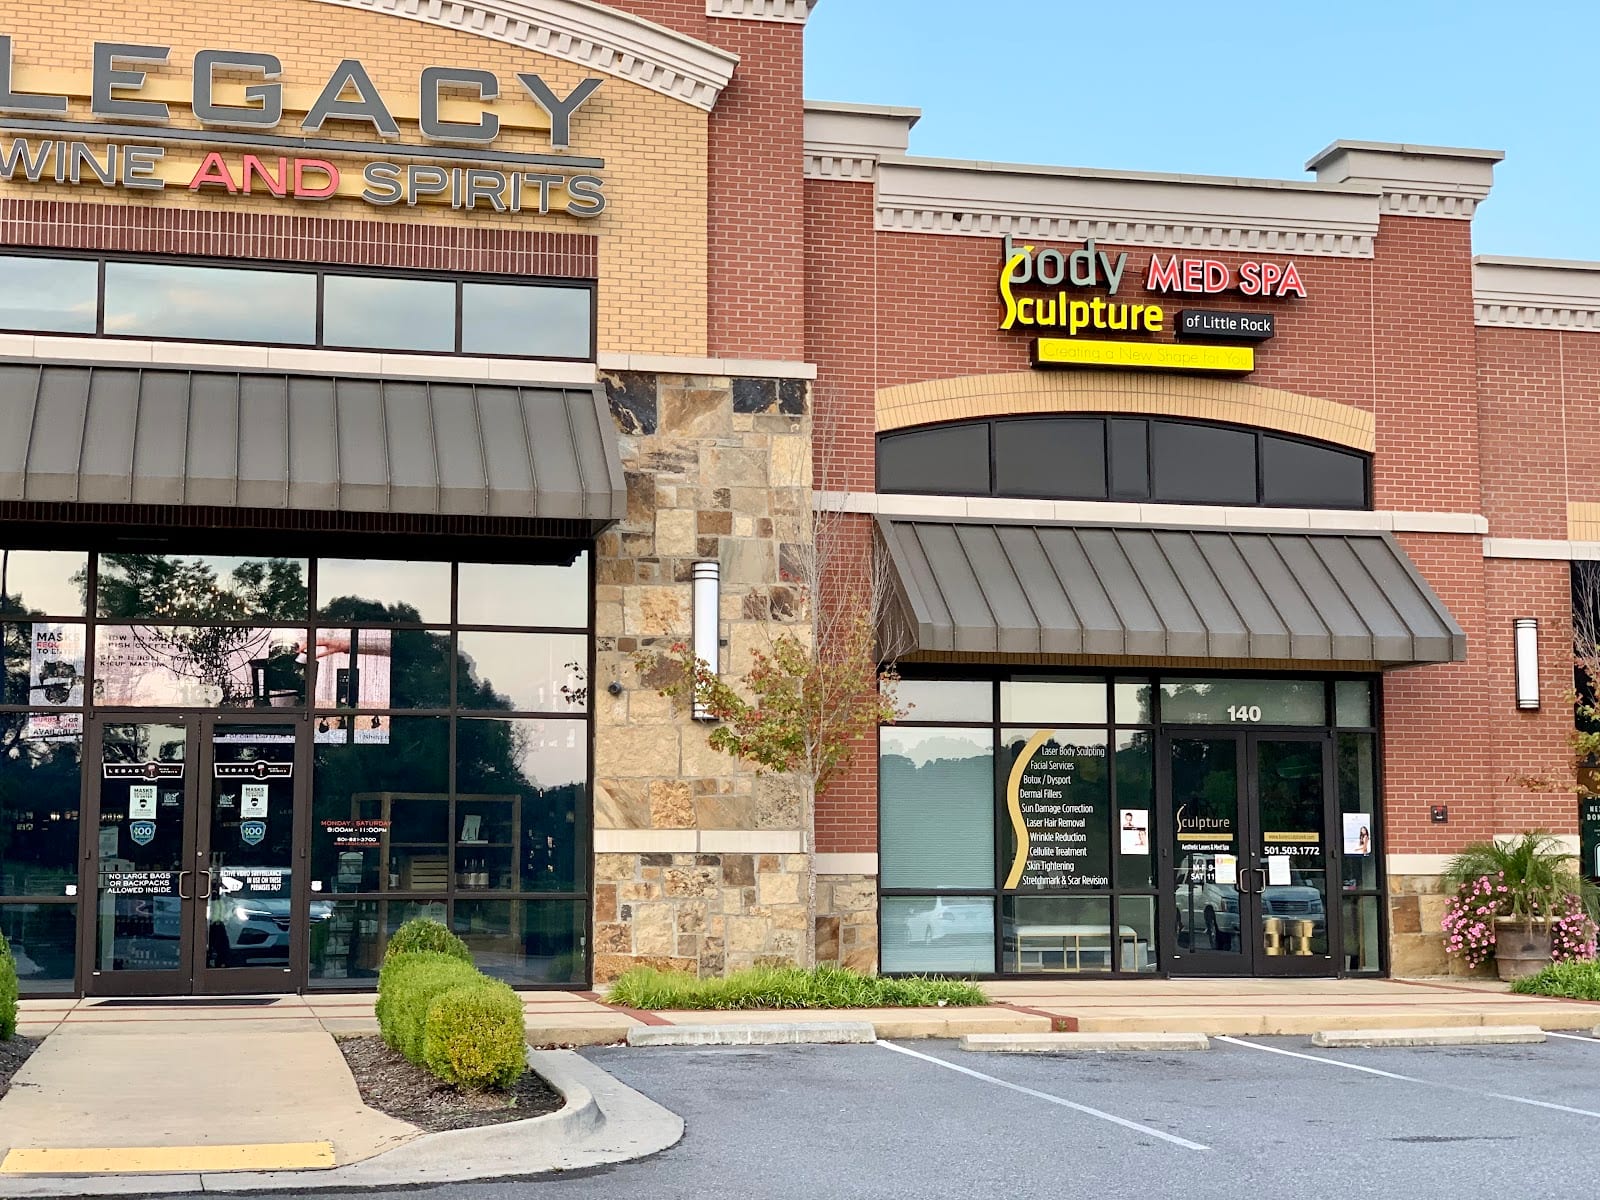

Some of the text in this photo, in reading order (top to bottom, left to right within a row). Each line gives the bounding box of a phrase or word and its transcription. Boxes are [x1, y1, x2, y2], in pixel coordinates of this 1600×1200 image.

[0, 35, 605, 150] LEGACY
[0, 138, 608, 217] WINE AND SPIRITS
[1004, 234, 1307, 298] body MED SPA
[1000, 246, 1271, 335] Sculpture of Little Rock
[1043, 342, 1248, 366] Creating a New Shape for You
[1227, 705, 1262, 722] 140
[1042, 746, 1105, 758] Laser Body Sculpting
[1030, 760, 1074, 770] Facial Services
[1023, 774, 1041, 784] Botox
[1046, 775, 1071, 785] Dysport
[1020, 789, 1062, 799] Dermal Fillers
[1021, 803, 1094, 814] Sun Damage Correction
[1026, 818, 1086, 828] Laser Hair Removal
[1176, 803, 1230, 833] Sculpture
[1030, 832, 1086, 842] Wrinkle Reduction
[1029, 847, 1087, 856] Cellulite Treatment
[1264, 846, 1320, 856] 501.503.1772
[1026, 861, 1075, 872] Skin Tightening
[1022, 876, 1061, 885] Stretchmark
[1067, 876, 1081, 885] Scar
[1082, 876, 1108, 885] Revision
